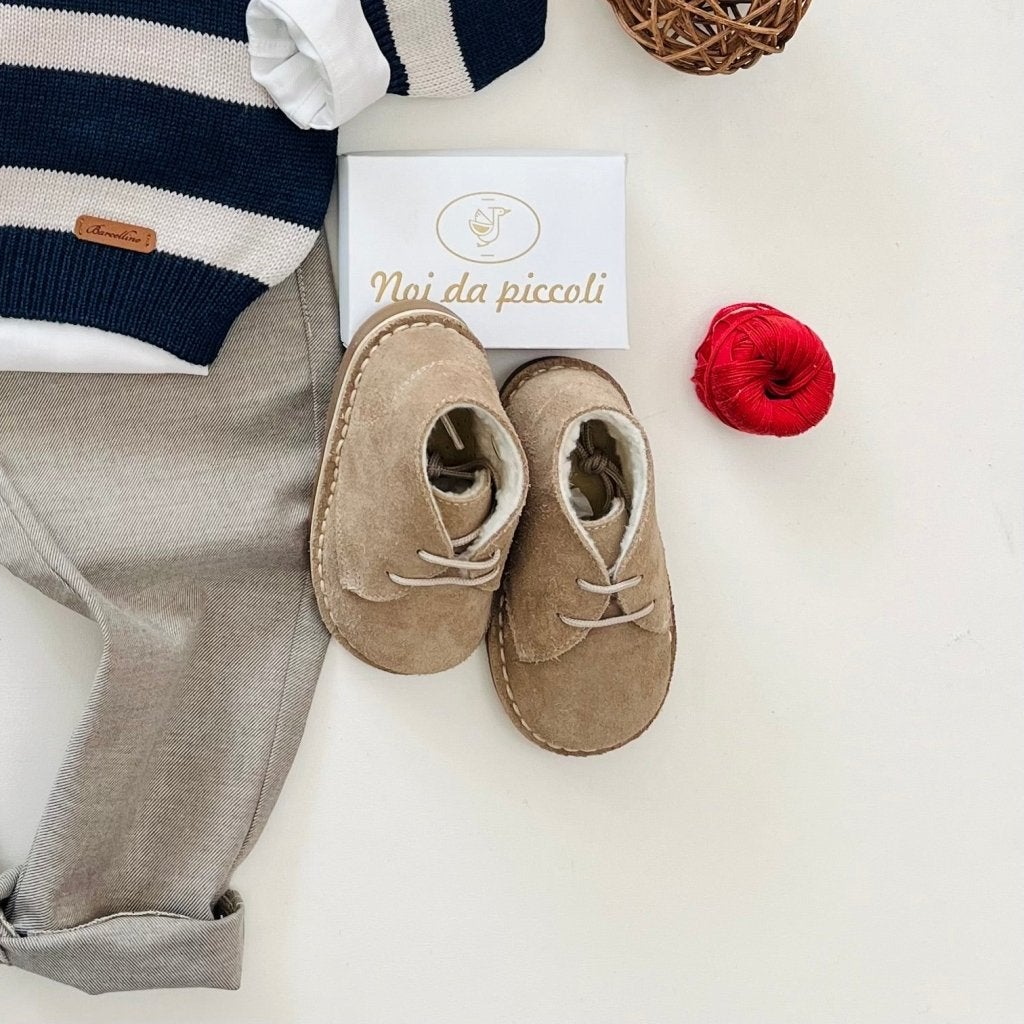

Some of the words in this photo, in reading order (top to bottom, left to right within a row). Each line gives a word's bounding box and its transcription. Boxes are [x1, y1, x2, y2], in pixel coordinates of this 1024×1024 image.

[370, 271, 435, 303] Noi
[440, 271, 488, 305] da
[495, 272, 608, 314] piccoli
